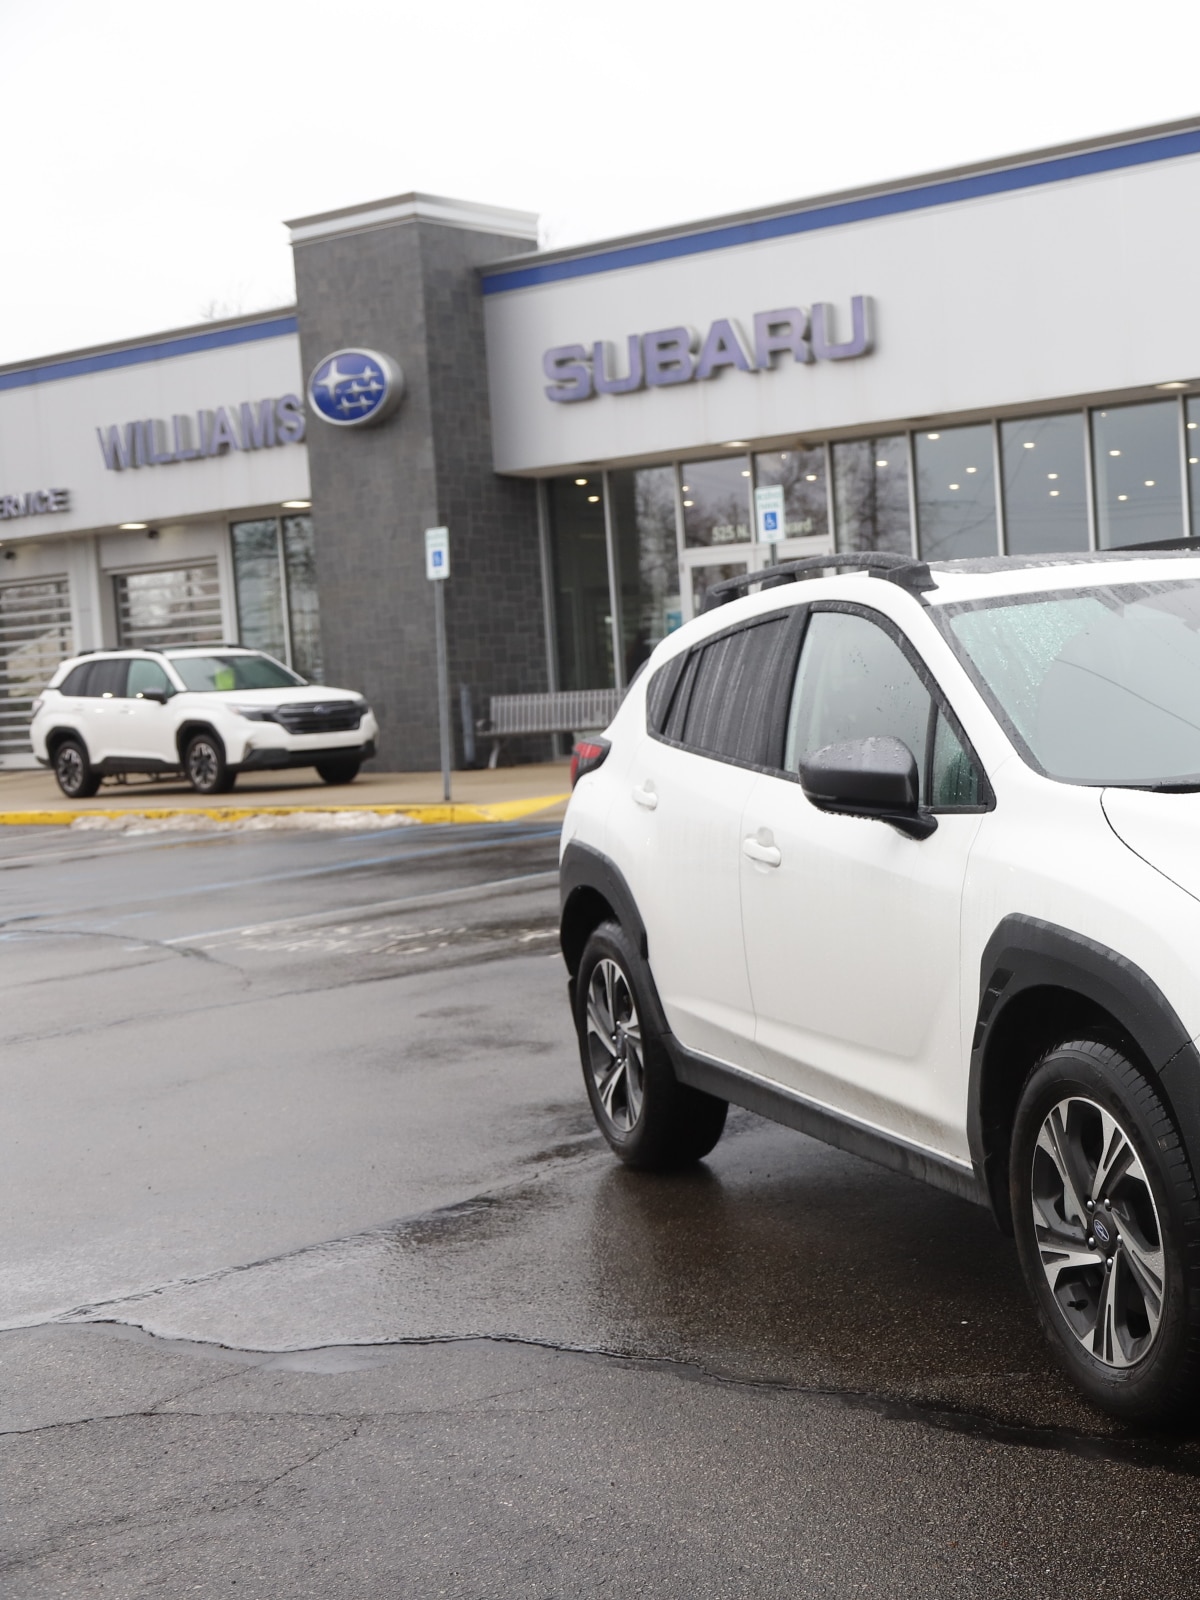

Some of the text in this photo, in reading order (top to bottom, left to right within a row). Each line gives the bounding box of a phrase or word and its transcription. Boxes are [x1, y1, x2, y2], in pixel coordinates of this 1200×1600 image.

[543, 295, 873, 403] SUBARU
[97, 393, 305, 470] WILLIAMS
[0, 488, 69, 520] RVICE
